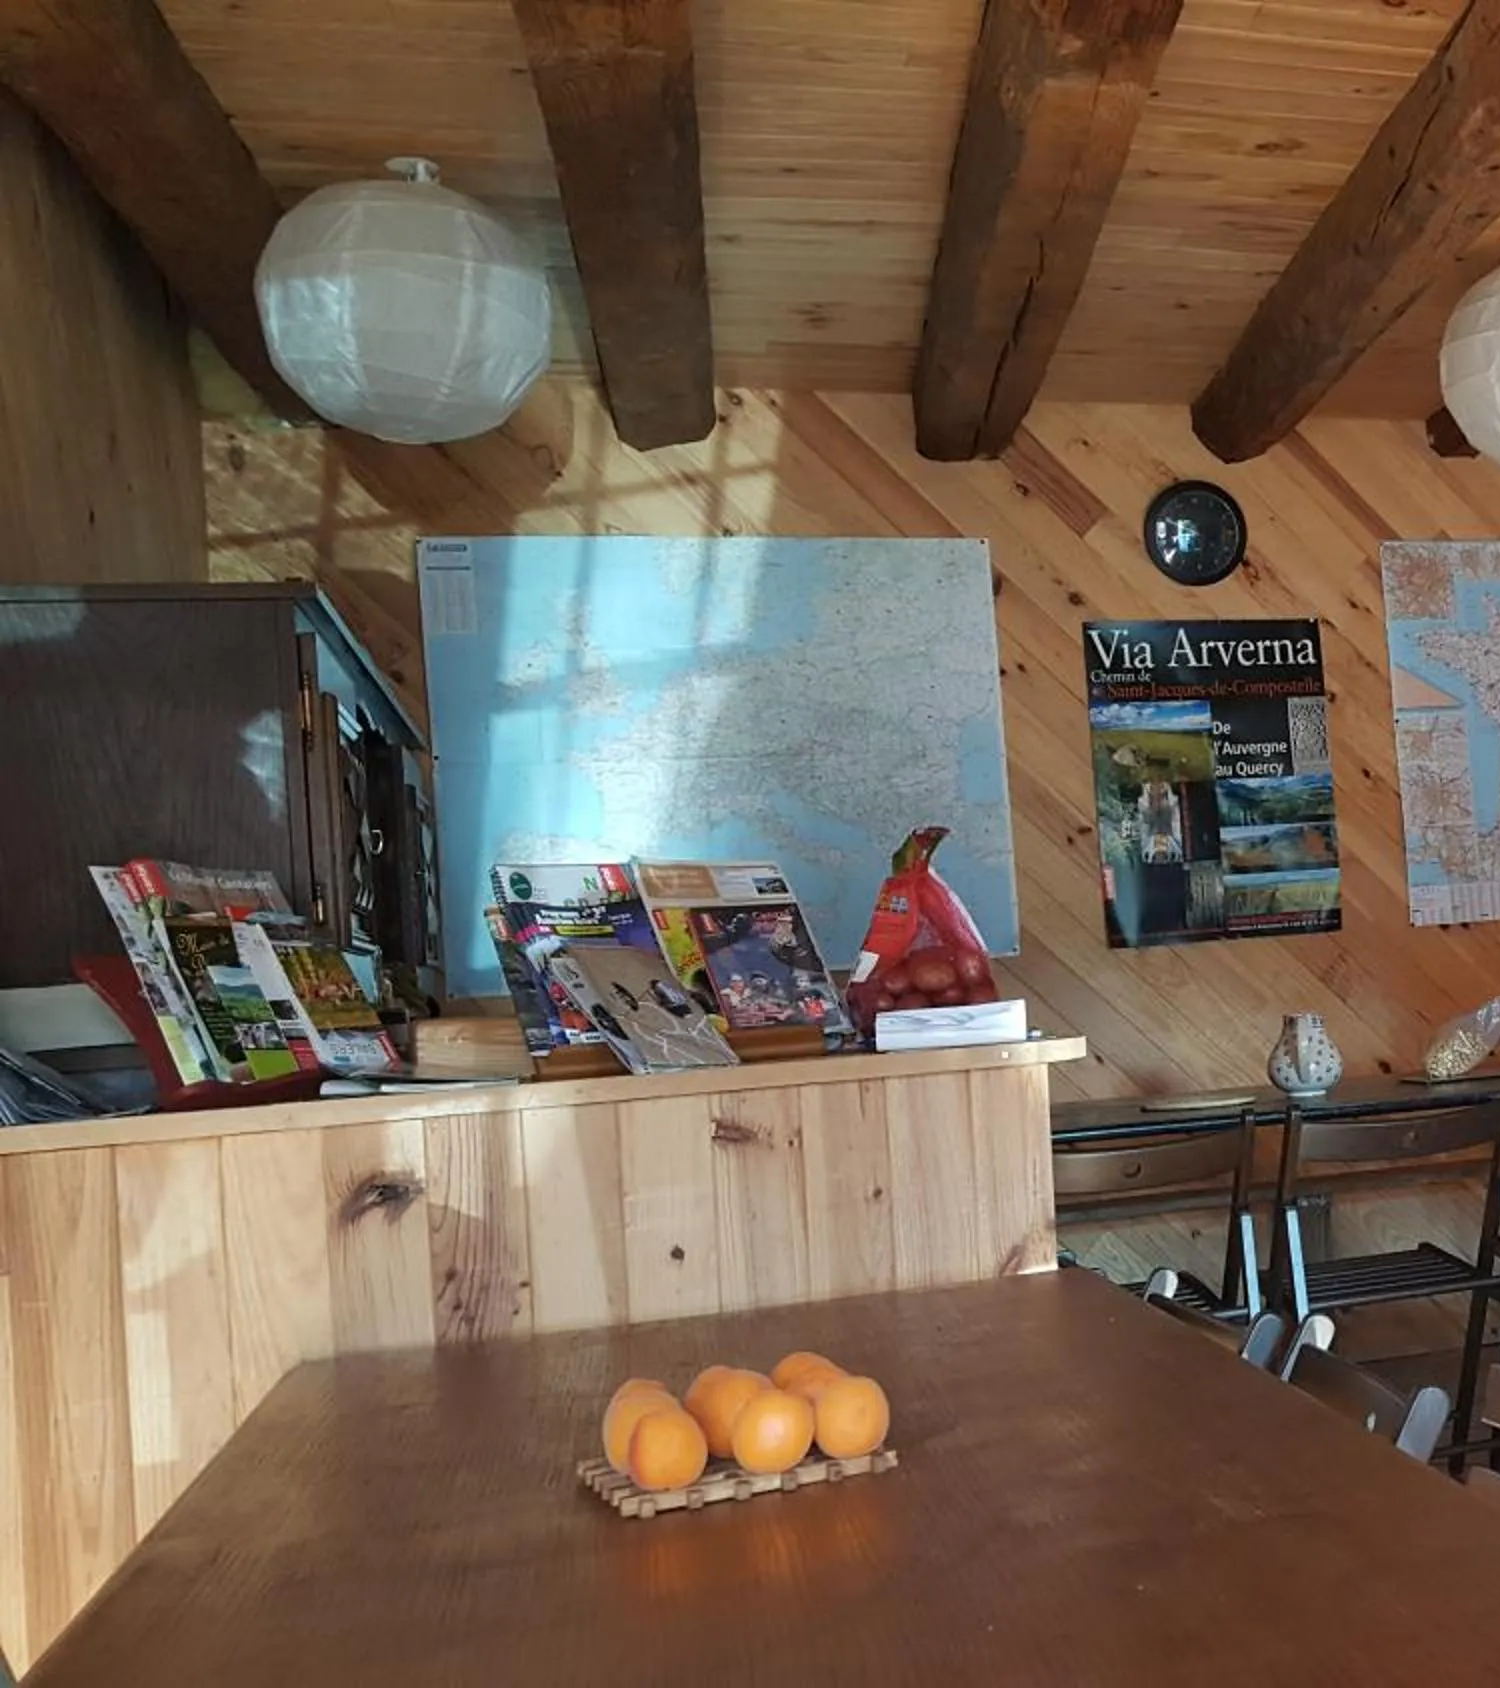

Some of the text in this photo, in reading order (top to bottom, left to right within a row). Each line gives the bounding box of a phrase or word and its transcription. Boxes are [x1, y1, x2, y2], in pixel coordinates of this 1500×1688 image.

[1088, 627, 1317, 669] Via Arverna
[1091, 668, 1151, 684] Chemin de
[1107, 677, 1322, 700] Saint-Jacques-de-Compostelle
[1213, 721, 1231, 735] De
[1213, 740, 1288, 757] l'Auvergne
[1215, 761, 1284, 776] au Quercy
